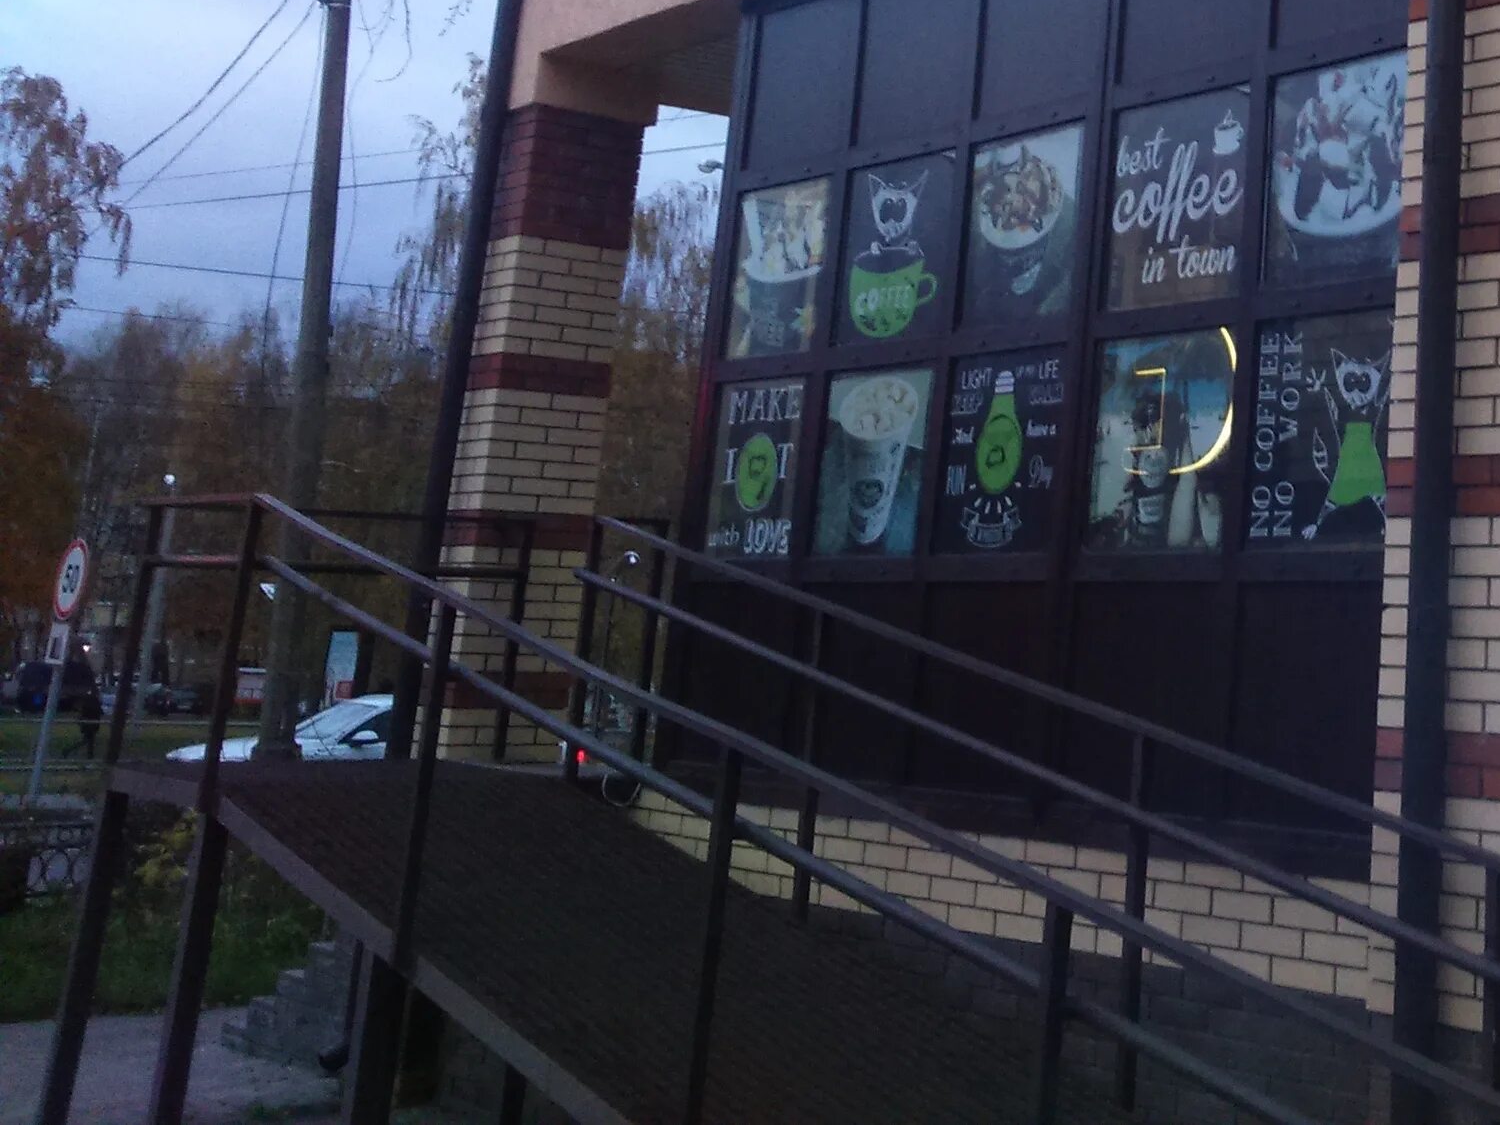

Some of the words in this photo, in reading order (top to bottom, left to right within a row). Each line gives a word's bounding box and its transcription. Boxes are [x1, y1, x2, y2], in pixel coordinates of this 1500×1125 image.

[1116, 126, 1171, 177] best
[1112, 140, 1244, 243] coffee
[1141, 246, 1165, 284] in
[1168, 234, 1236, 279] town
[1038, 359, 1060, 379] LIFE
[1279, 330, 1303, 442] WORK
[728, 385, 804, 425] MAKE
[1254, 333, 1280, 471] COFFEE
[1250, 485, 1271, 537] NO
[1273, 481, 1295, 537] NO
[707, 523, 740, 547] with
